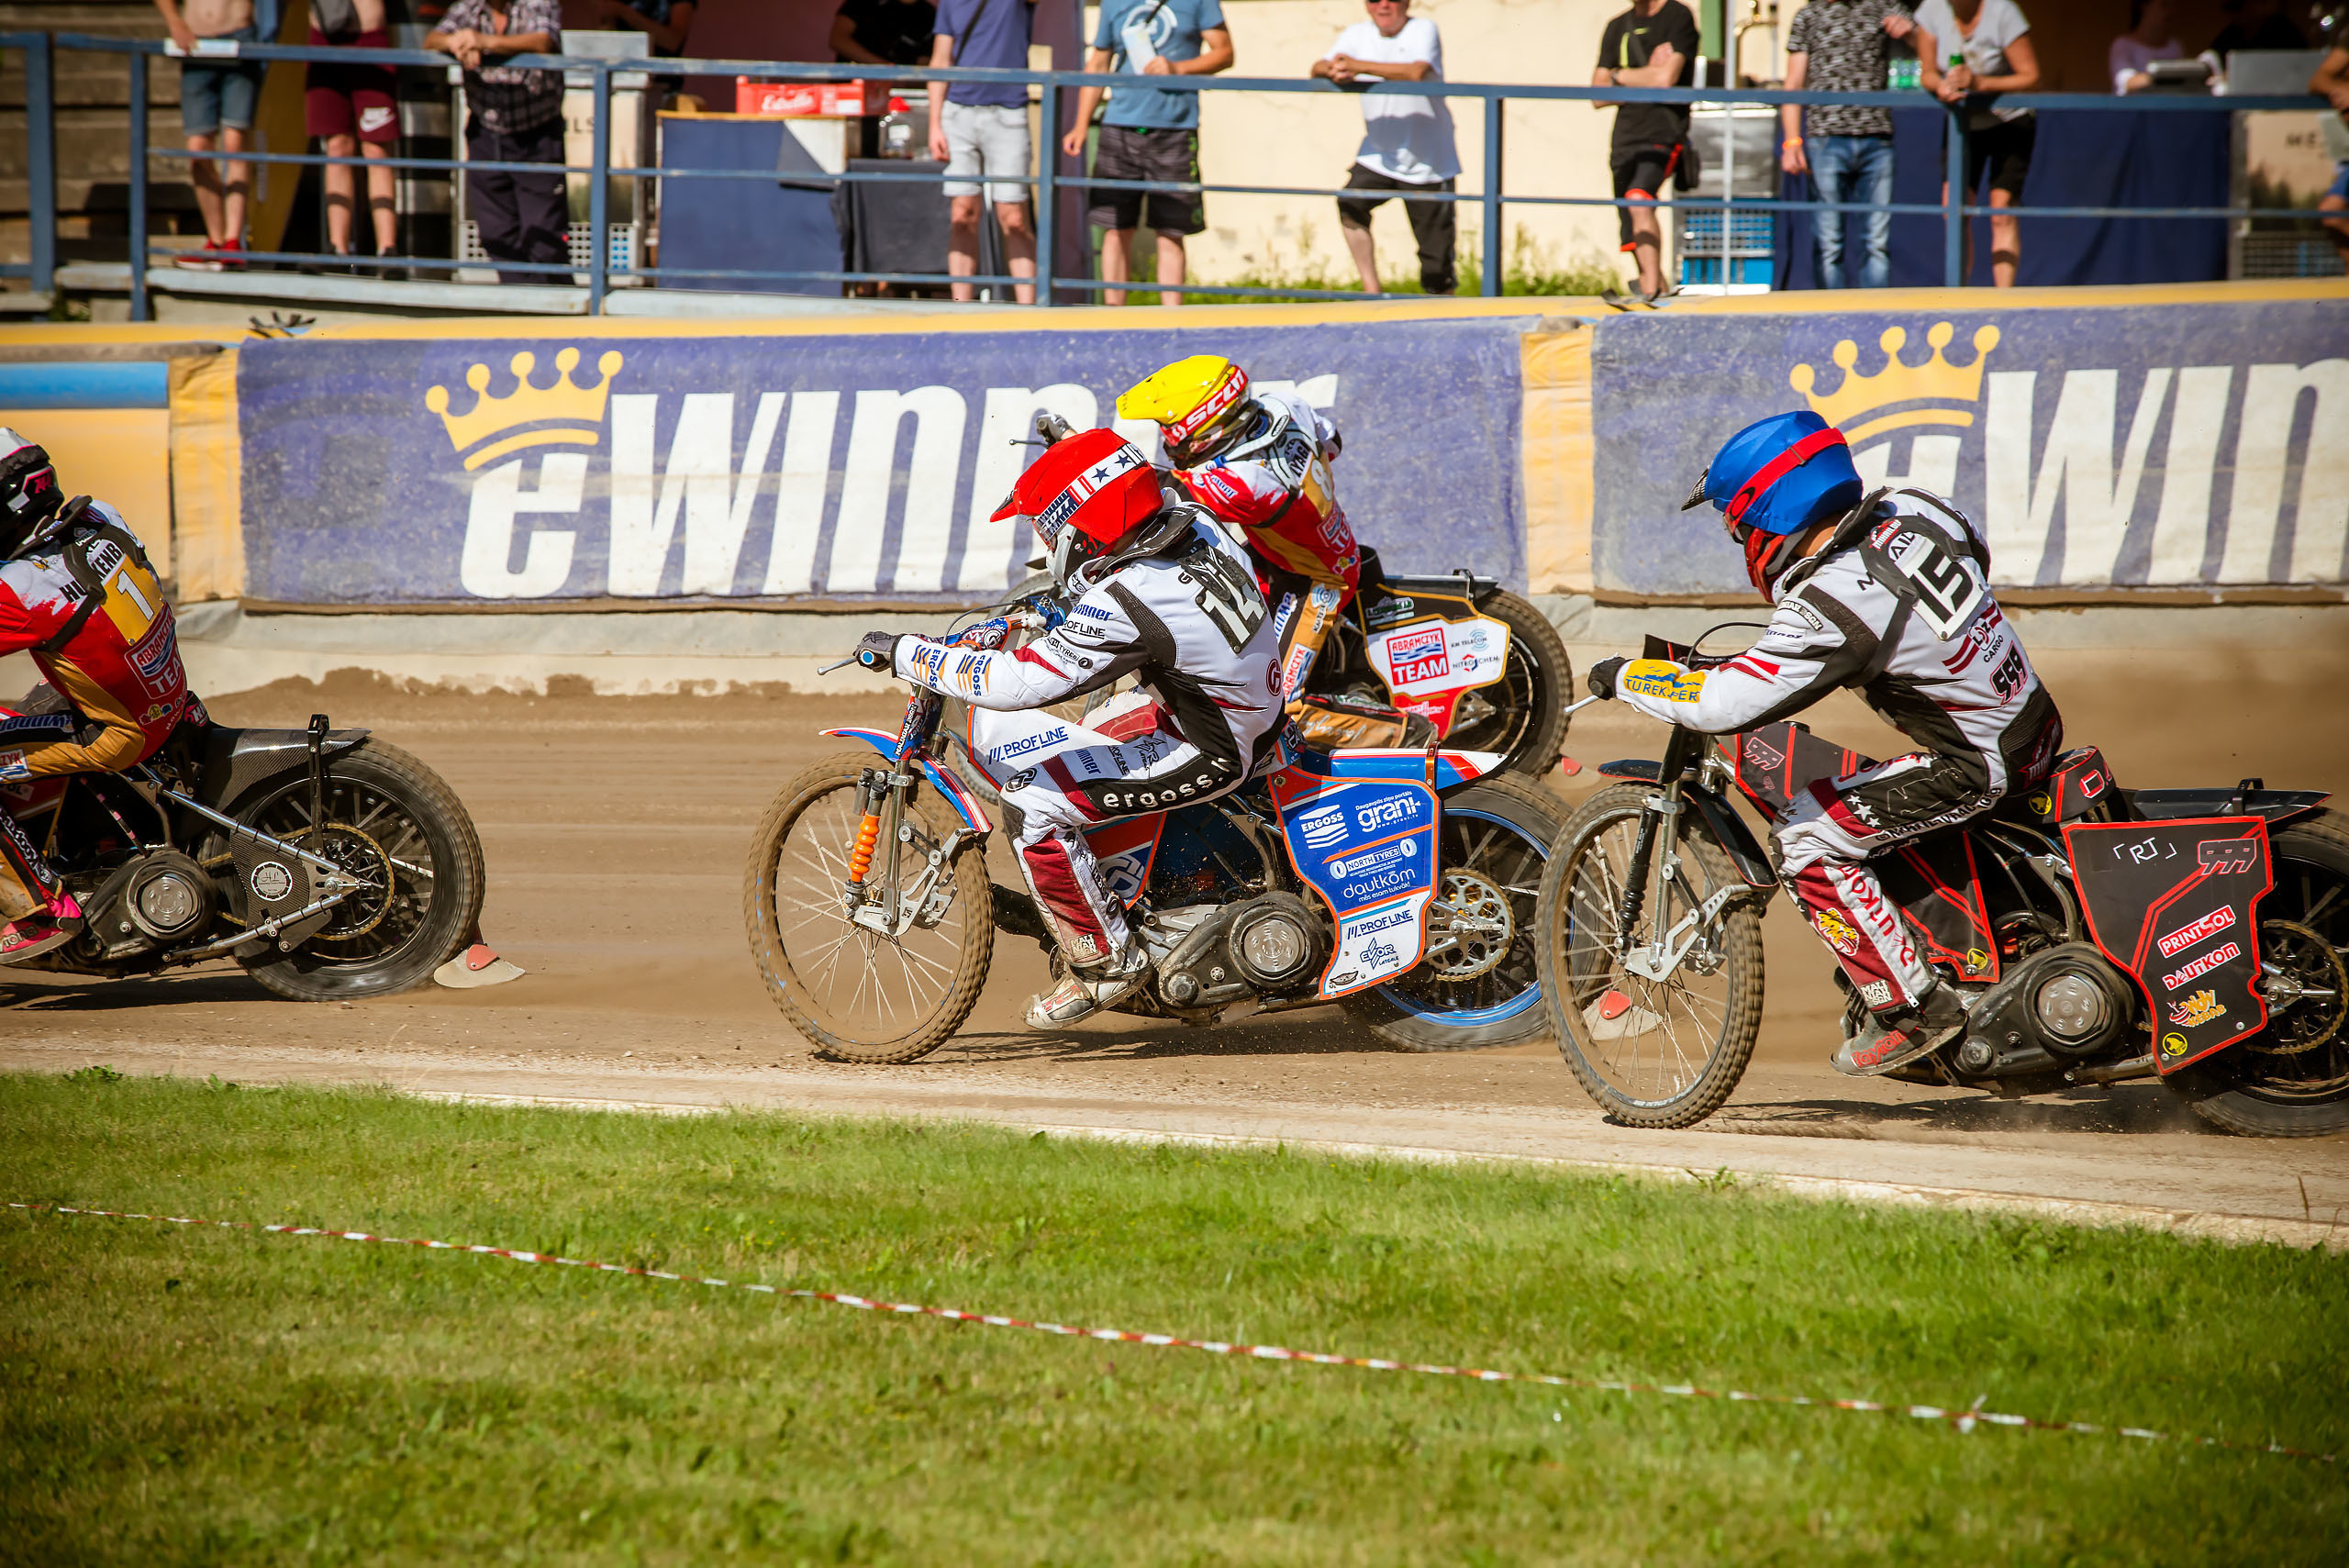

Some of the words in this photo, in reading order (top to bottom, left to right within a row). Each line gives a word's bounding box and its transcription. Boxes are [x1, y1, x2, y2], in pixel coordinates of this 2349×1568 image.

[116, 568, 155, 622] 1
[1909, 550, 1975, 625] 15
[1392, 631, 1441, 651] ABRAMCZYK
[1983, 634, 2004, 663] CARGO
[1393, 660, 1448, 684] TEAM
[1300, 812, 1344, 833] ERGOSS
[1347, 853, 1374, 871] NORTH
[1375, 847, 1400, 862] TYRES
[2161, 908, 2235, 954] PRINTSOL
